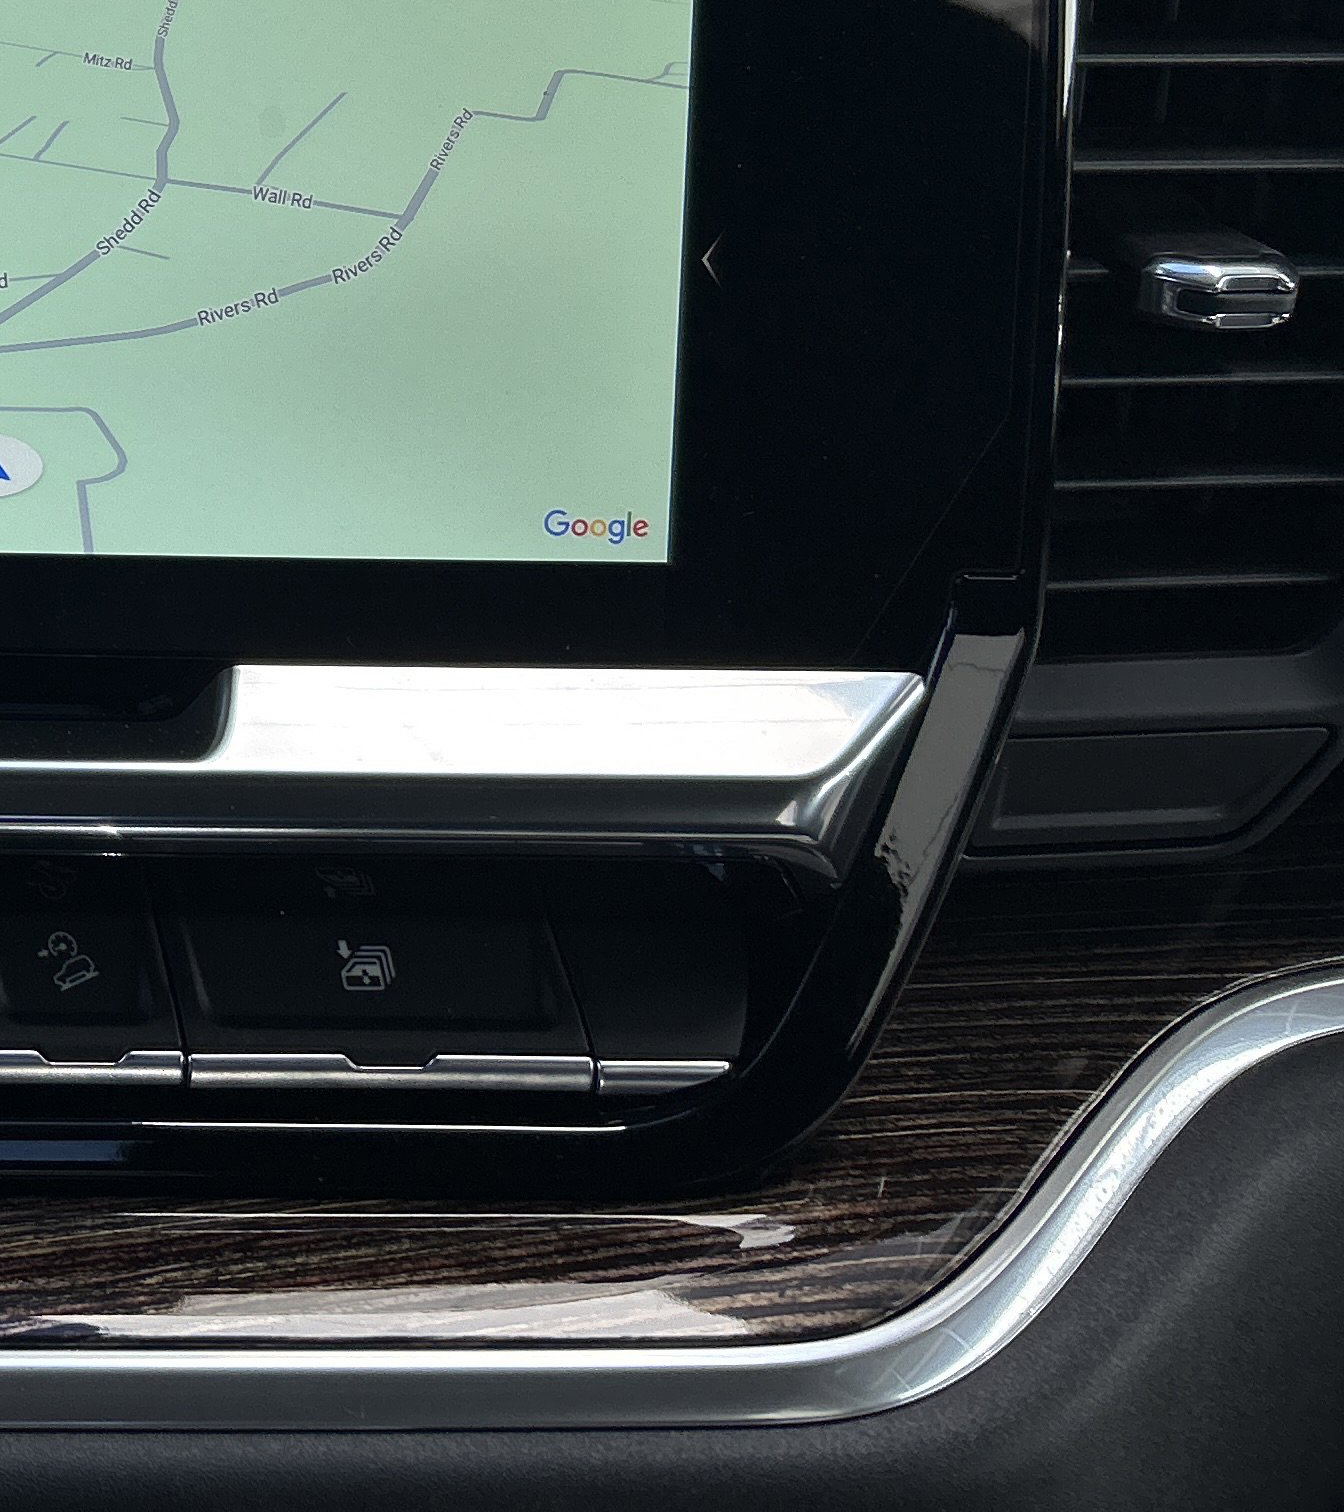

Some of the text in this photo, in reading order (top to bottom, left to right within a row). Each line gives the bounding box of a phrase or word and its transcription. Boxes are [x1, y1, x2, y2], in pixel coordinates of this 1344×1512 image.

[157, 0, 178, 38] Shedd
[83, 52, 133, 70] Mitz Rd
[429, 108, 474, 171] Rivers Rd
[253, 185, 314, 209] Wall Rd
[95, 188, 162, 256] Shedd Rd
[331, 226, 403, 285] Rivers Rd
[197, 287, 280, 326] Rivers Rd
[543, 508, 649, 545] Google
